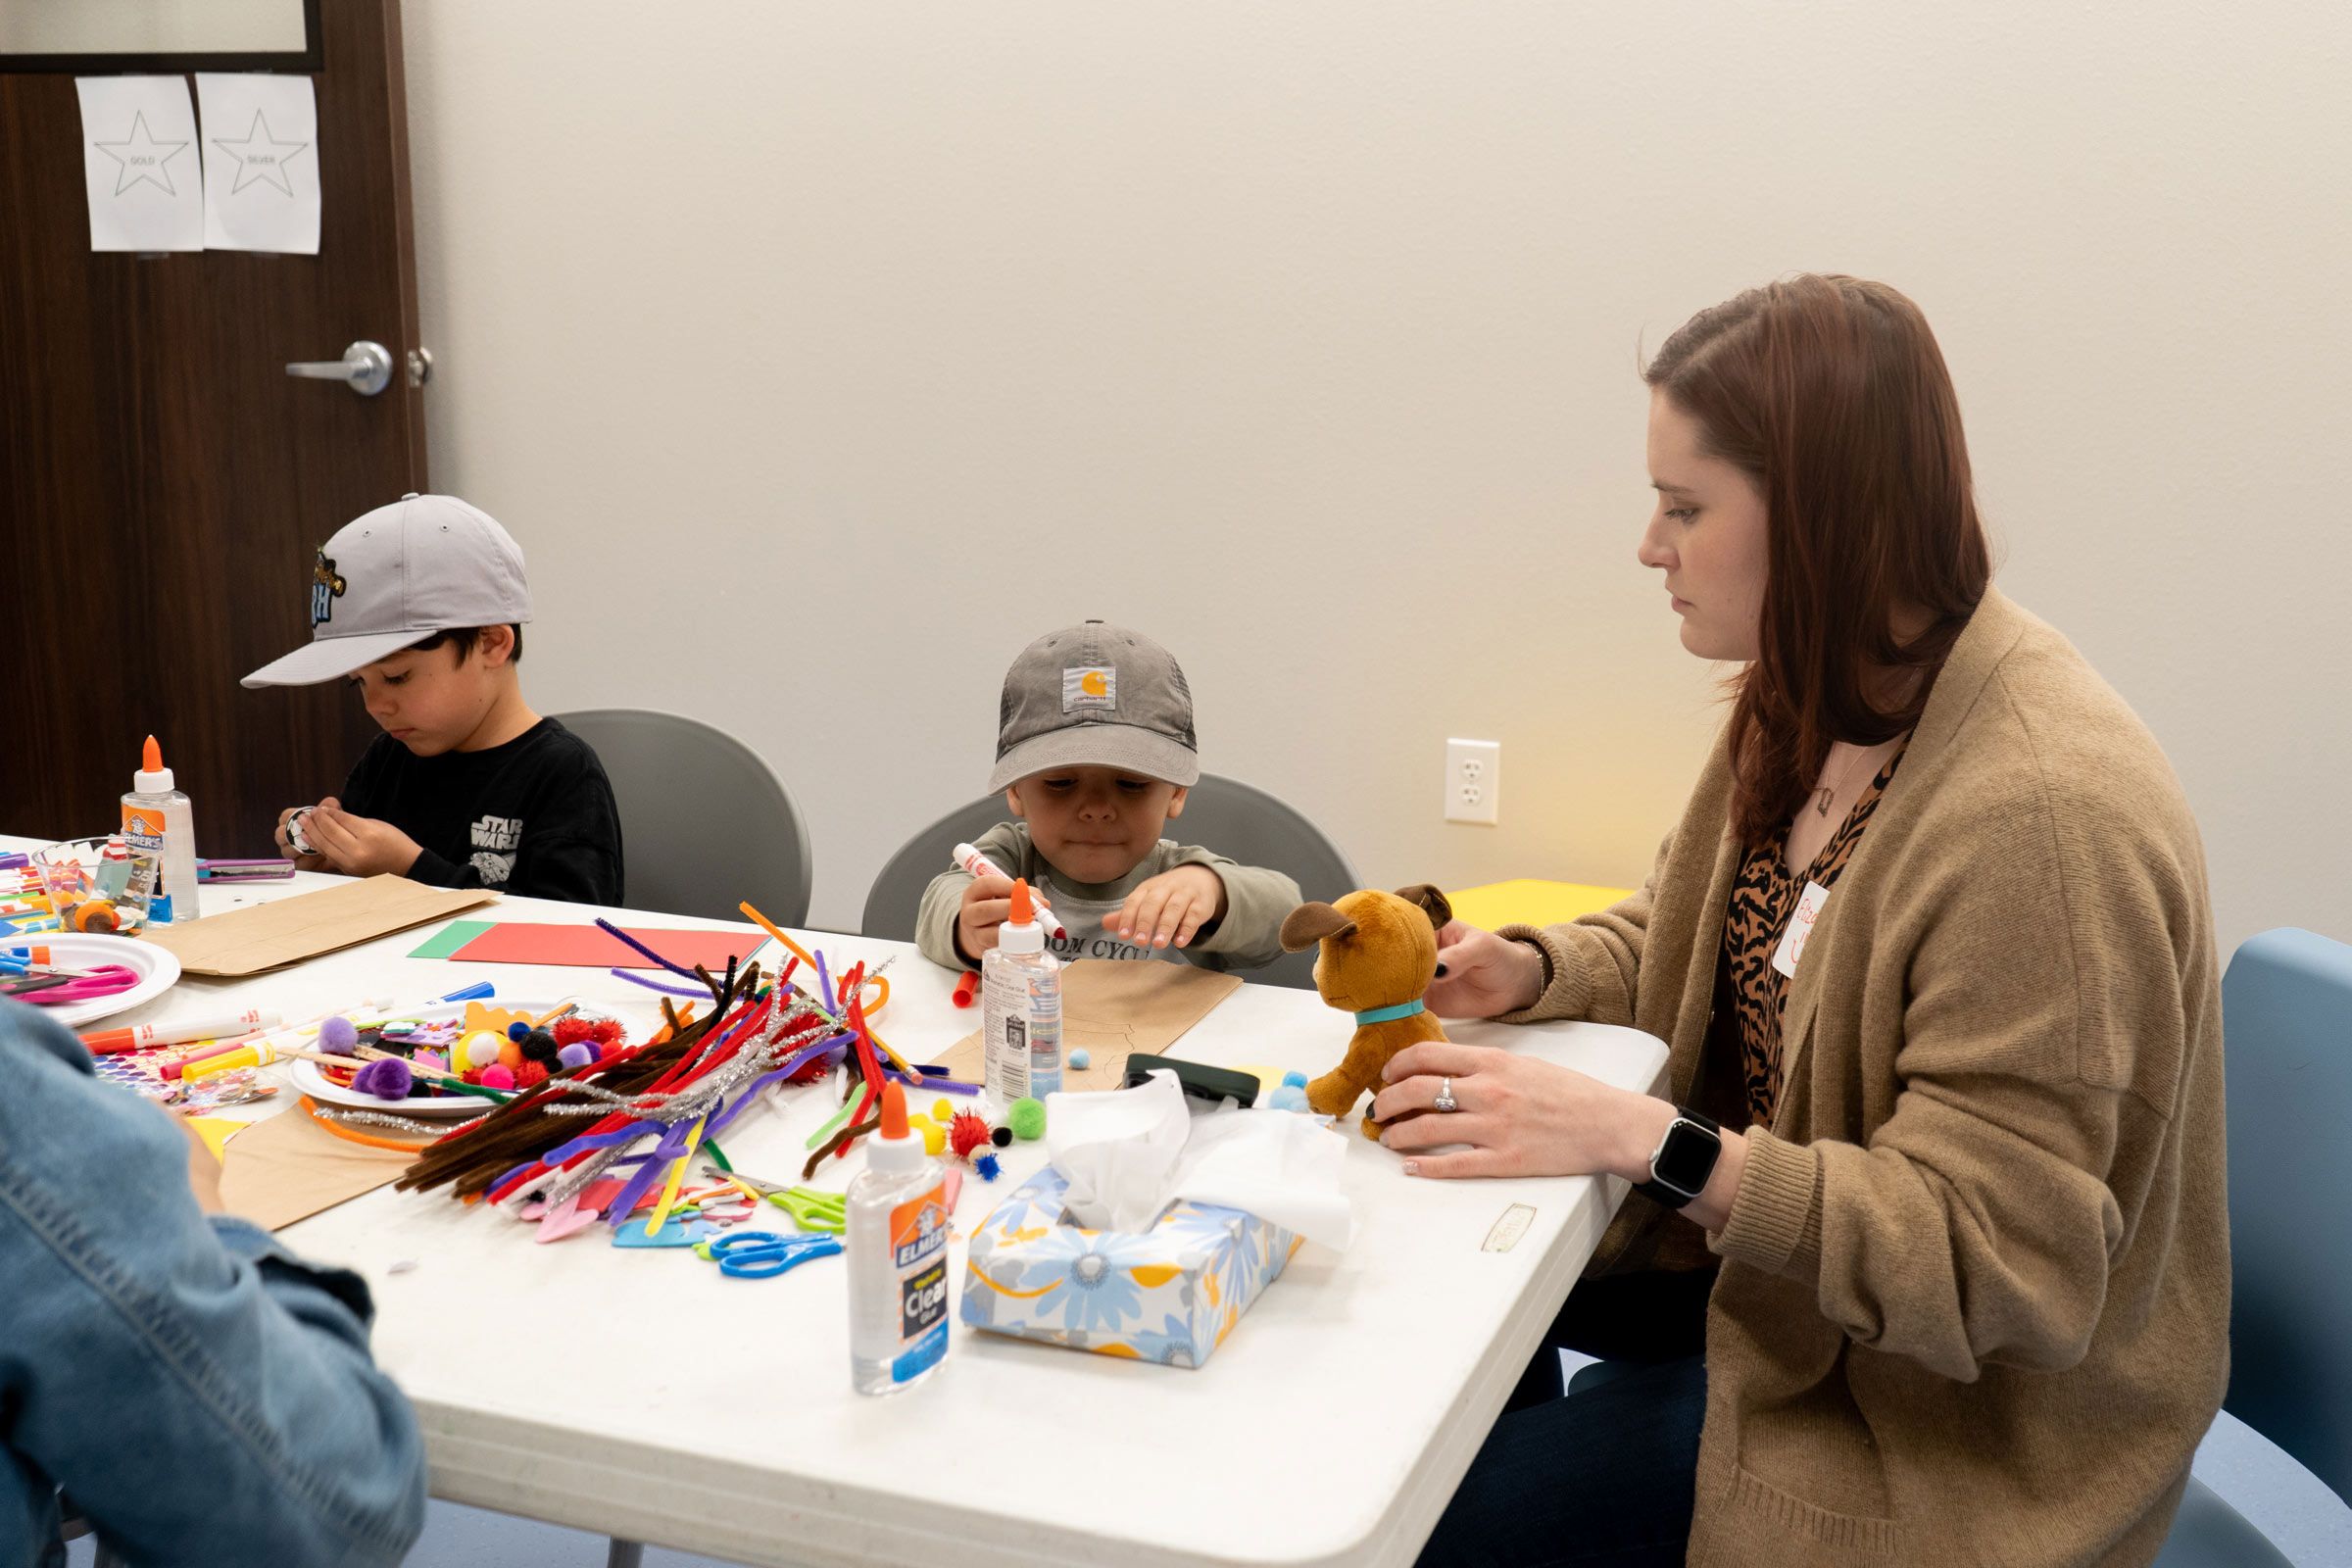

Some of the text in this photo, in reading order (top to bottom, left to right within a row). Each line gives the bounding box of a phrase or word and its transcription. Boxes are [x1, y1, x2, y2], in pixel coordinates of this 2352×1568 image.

[470, 814, 523, 835] STAR
[470, 828, 520, 850] WARS
[906, 1277, 947, 1318] Clear
